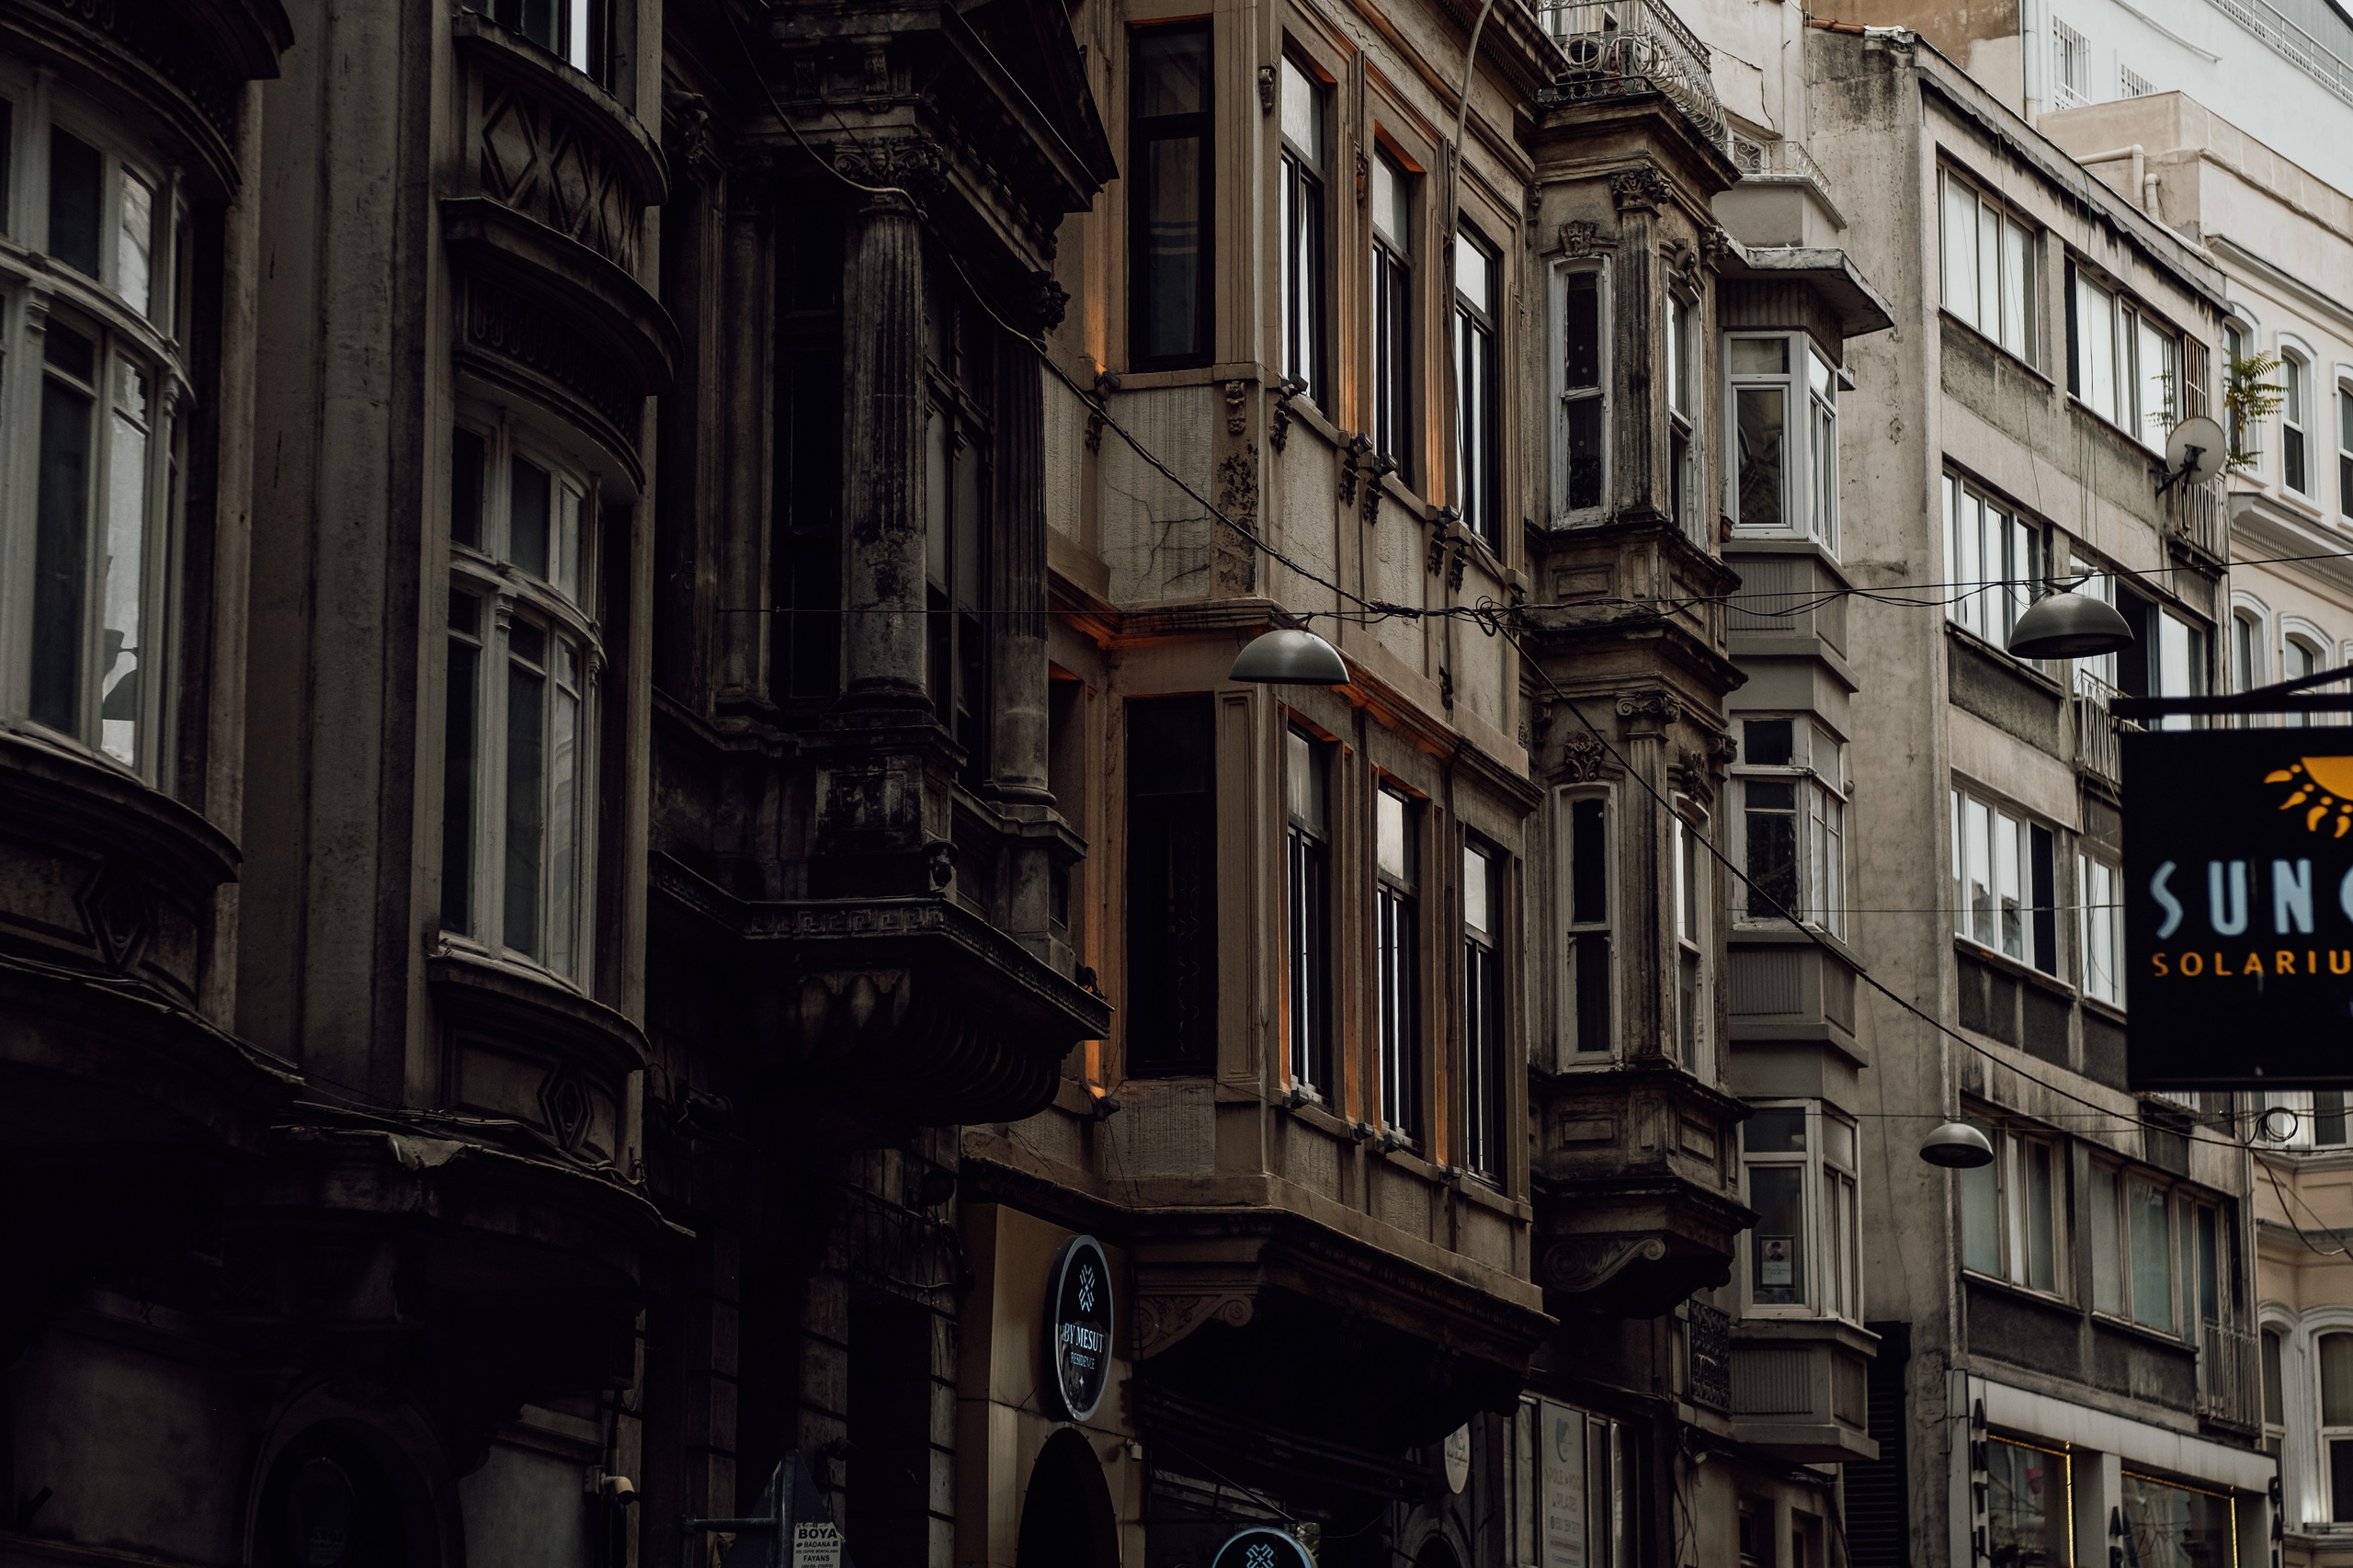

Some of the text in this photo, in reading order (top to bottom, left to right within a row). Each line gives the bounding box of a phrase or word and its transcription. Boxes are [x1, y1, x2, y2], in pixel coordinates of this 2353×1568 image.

[2151, 949, 2353, 978] SOLARIU
[1064, 1323, 1104, 1353] BY MESUT
[1070, 1352, 1095, 1369] RESIDENCE
[799, 1528, 837, 1540] BOYA
